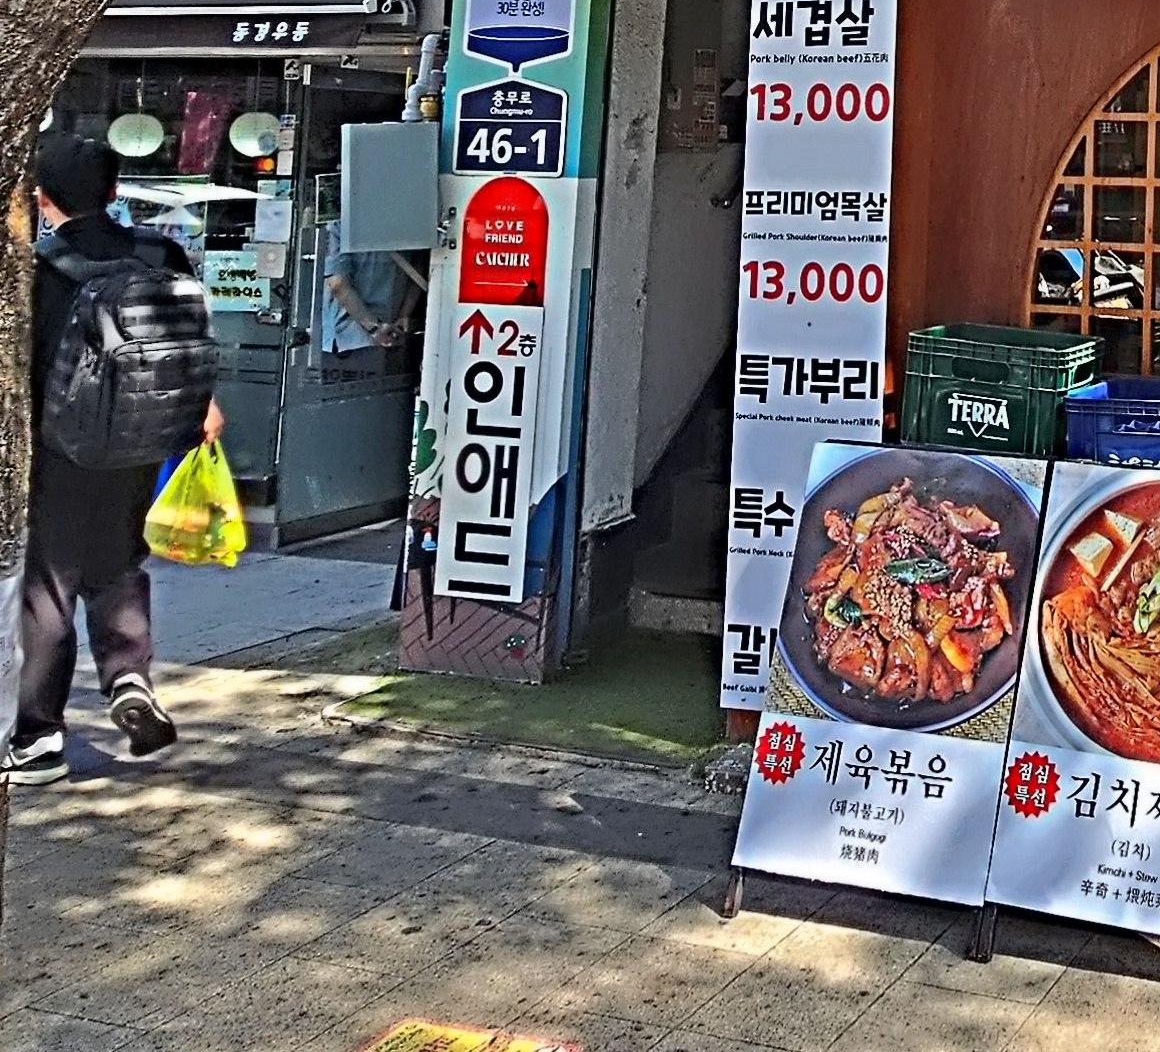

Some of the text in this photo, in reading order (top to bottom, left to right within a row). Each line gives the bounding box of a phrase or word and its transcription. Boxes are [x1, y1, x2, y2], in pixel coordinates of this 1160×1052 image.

[521, 1, 545, 16] 완성!
[233, 22, 309, 42] 동경우동
[752, 0, 875, 47] 세겹살
[750, 54, 771, 63] Pork
[773, 54, 796, 65] belly
[798, 53, 835, 64] (Korean
[492, 90, 533, 107] 충무로
[750, 83, 890, 126] 13,000
[489, 107, 534, 117] Chungmu-ro
[466, 127, 548, 165] 46-1
[744, 190, 887, 222] 프리미엄목살
[485, 233, 524, 245] FRIEND
[743, 232, 767, 241] Grilled
[768, 232, 784, 241] Pork
[742, 260, 884, 306] 13,000
[498, 319, 537, 358] 2층
[738, 354, 880, 404] 특가부리
[735, 412, 758, 421] Special
[758, 413, 774, 421] Pork
[947, 396, 1010, 430] TERRA
[448, 360, 526, 598] 인애드
[734, 488, 796, 538] 특수
[767, 732, 797, 752] 점심
[763, 754, 793, 775] 특선
[809, 739, 953, 799] 제육볶음
[1018, 762, 1050, 784] 점심
[1013, 785, 1047, 809] 특선
[829, 798, 905, 826] (돼지불고기)
[838, 826, 887, 844] Pork Bulgogi
[1111, 839, 1151, 862] (김치)
[1097, 863, 1127, 878] Kimchi
[1135, 869, 1159, 884] Stew
